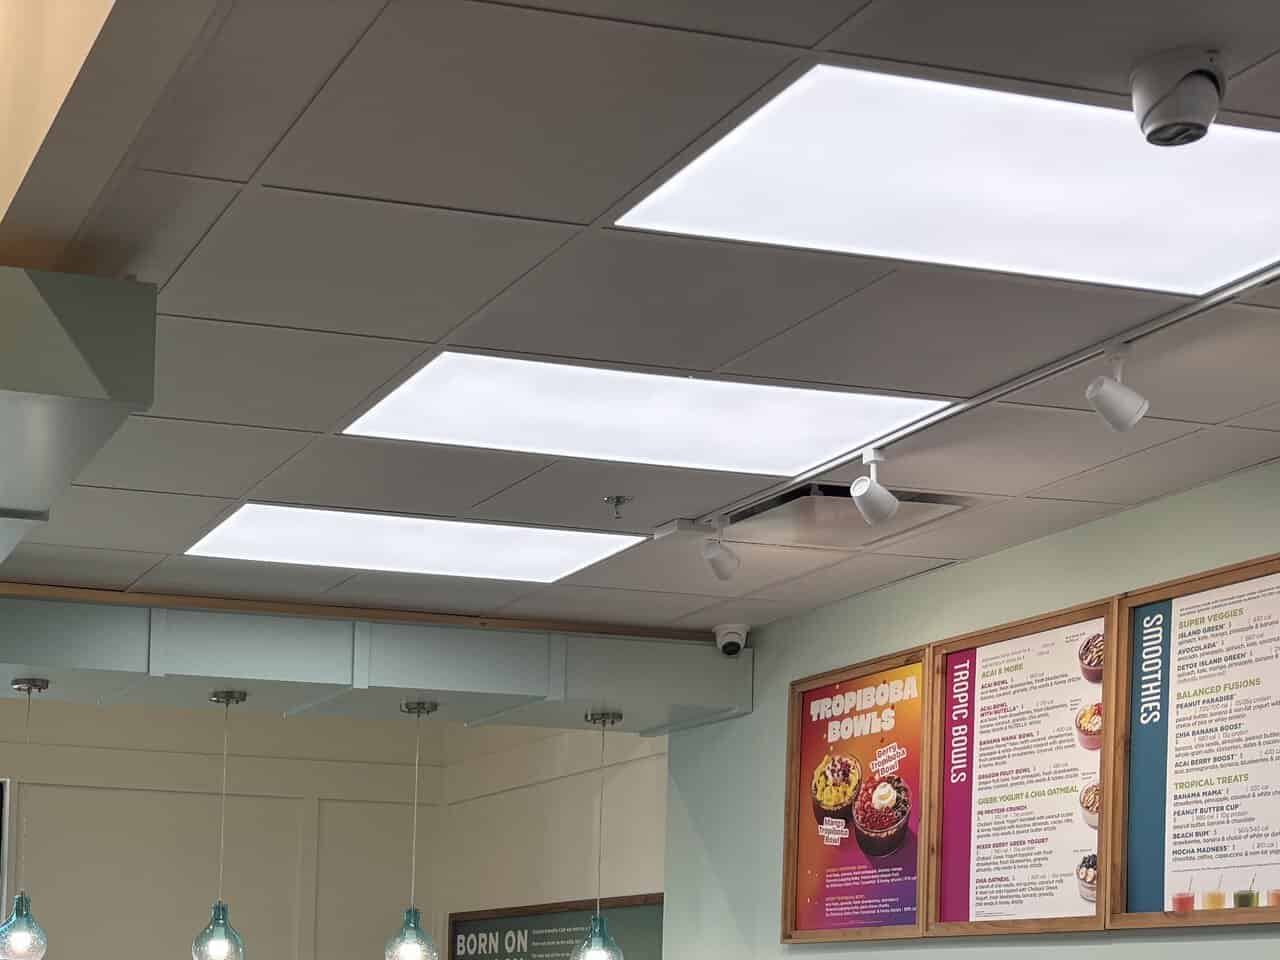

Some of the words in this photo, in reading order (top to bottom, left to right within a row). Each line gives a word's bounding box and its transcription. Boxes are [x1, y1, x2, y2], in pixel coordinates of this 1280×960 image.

[1178, 618, 1205, 629] SUPER
[1207, 608, 1243, 622] VEGGIES
[1140, 613, 1163, 725] SMOOTHIES
[810, 676, 918, 721] TROPIBOBA
[951, 659, 970, 721] TROPIC
[1176, 686, 1221, 699] BALANCED
[1223, 678, 1261, 690] FUSIONS
[827, 709, 896, 743] BOWLS
[1191, 727, 1218, 735] BANANA
[1219, 723, 1241, 731] BOOST
[950, 726, 968, 784] BOWLS
[1190, 758, 1210, 766] BERRY
[1213, 754, 1233, 762] BOOST
[1174, 779, 1214, 790] TROPICAL
[1217, 773, 1248, 784] TREATS
[977, 796, 998, 804] GREEK
[999, 793, 1024, 801] YOGURT
[1030, 790, 1045, 798] CHIA
[1047, 785, 1078, 795] OATMEAL
[1173, 809, 1197, 817] PEANUT
[1199, 805, 1224, 813] BUTTER
[1172, 832, 1193, 840] BEACH
[1196, 845, 1226, 853] MADNESS
[456, 931, 499, 956] BORN
[504, 929, 528, 953] ON
